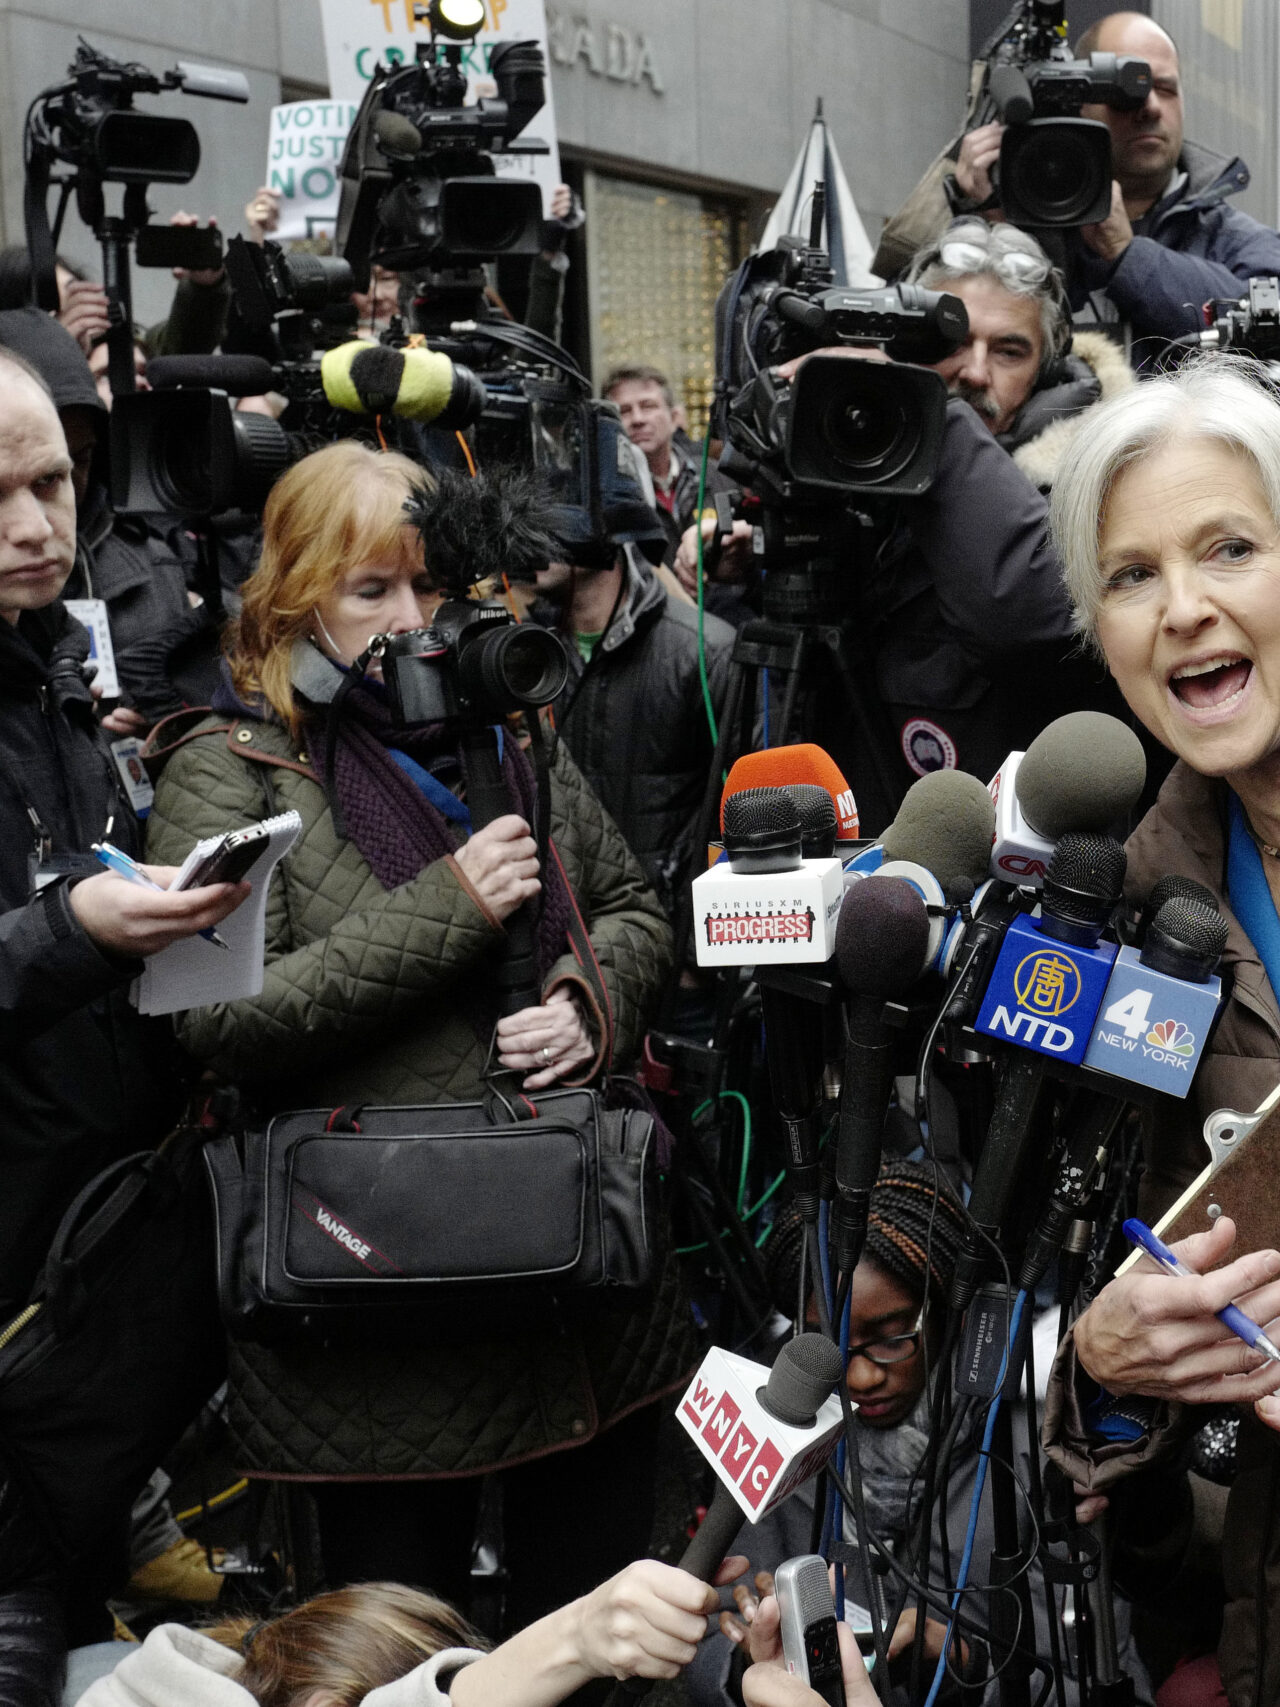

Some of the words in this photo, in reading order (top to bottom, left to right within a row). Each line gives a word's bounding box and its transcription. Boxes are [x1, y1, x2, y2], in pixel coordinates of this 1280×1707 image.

[371, 0, 508, 33] TRP
[272, 136, 346, 160] JUST
[271, 167, 335, 200] NO
[480, 609, 507, 619] Nikon
[998, 854, 1047, 880] CN
[712, 899, 803, 910] SIRIUSXM
[711, 916, 808, 941] PROGRESS
[988, 1004, 1075, 1052] NTD
[1104, 988, 1154, 1040] 4
[1097, 1030, 1138, 1052] NEW
[1142, 1045, 1192, 1071] YORK
[316, 1207, 371, 1260] VANTAGE
[972, 1312, 988, 1369] SENNHEISER
[692, 1378, 769, 1491] WNYC
